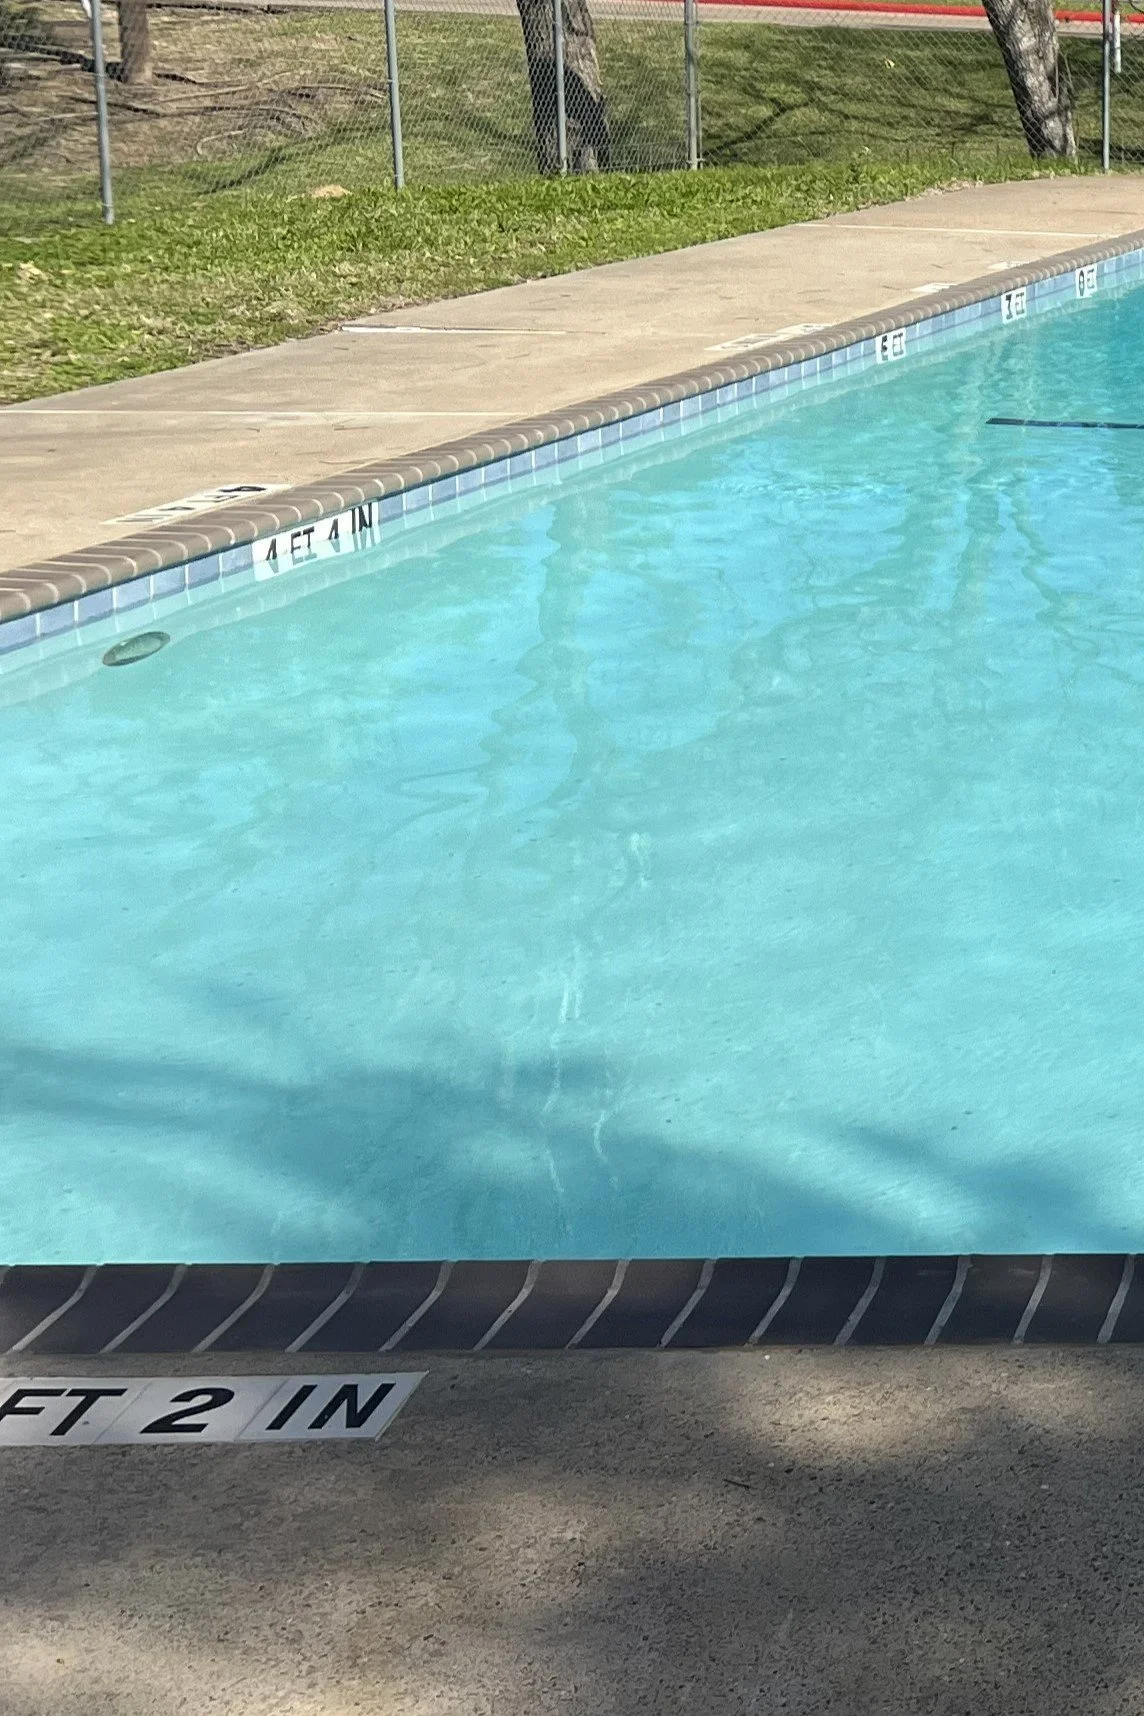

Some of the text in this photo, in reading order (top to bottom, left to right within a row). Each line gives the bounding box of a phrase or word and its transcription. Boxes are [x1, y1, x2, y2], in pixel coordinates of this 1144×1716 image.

[351, 502, 374, 539] IN
[0, 1382, 397, 1437] FT 2 IN
